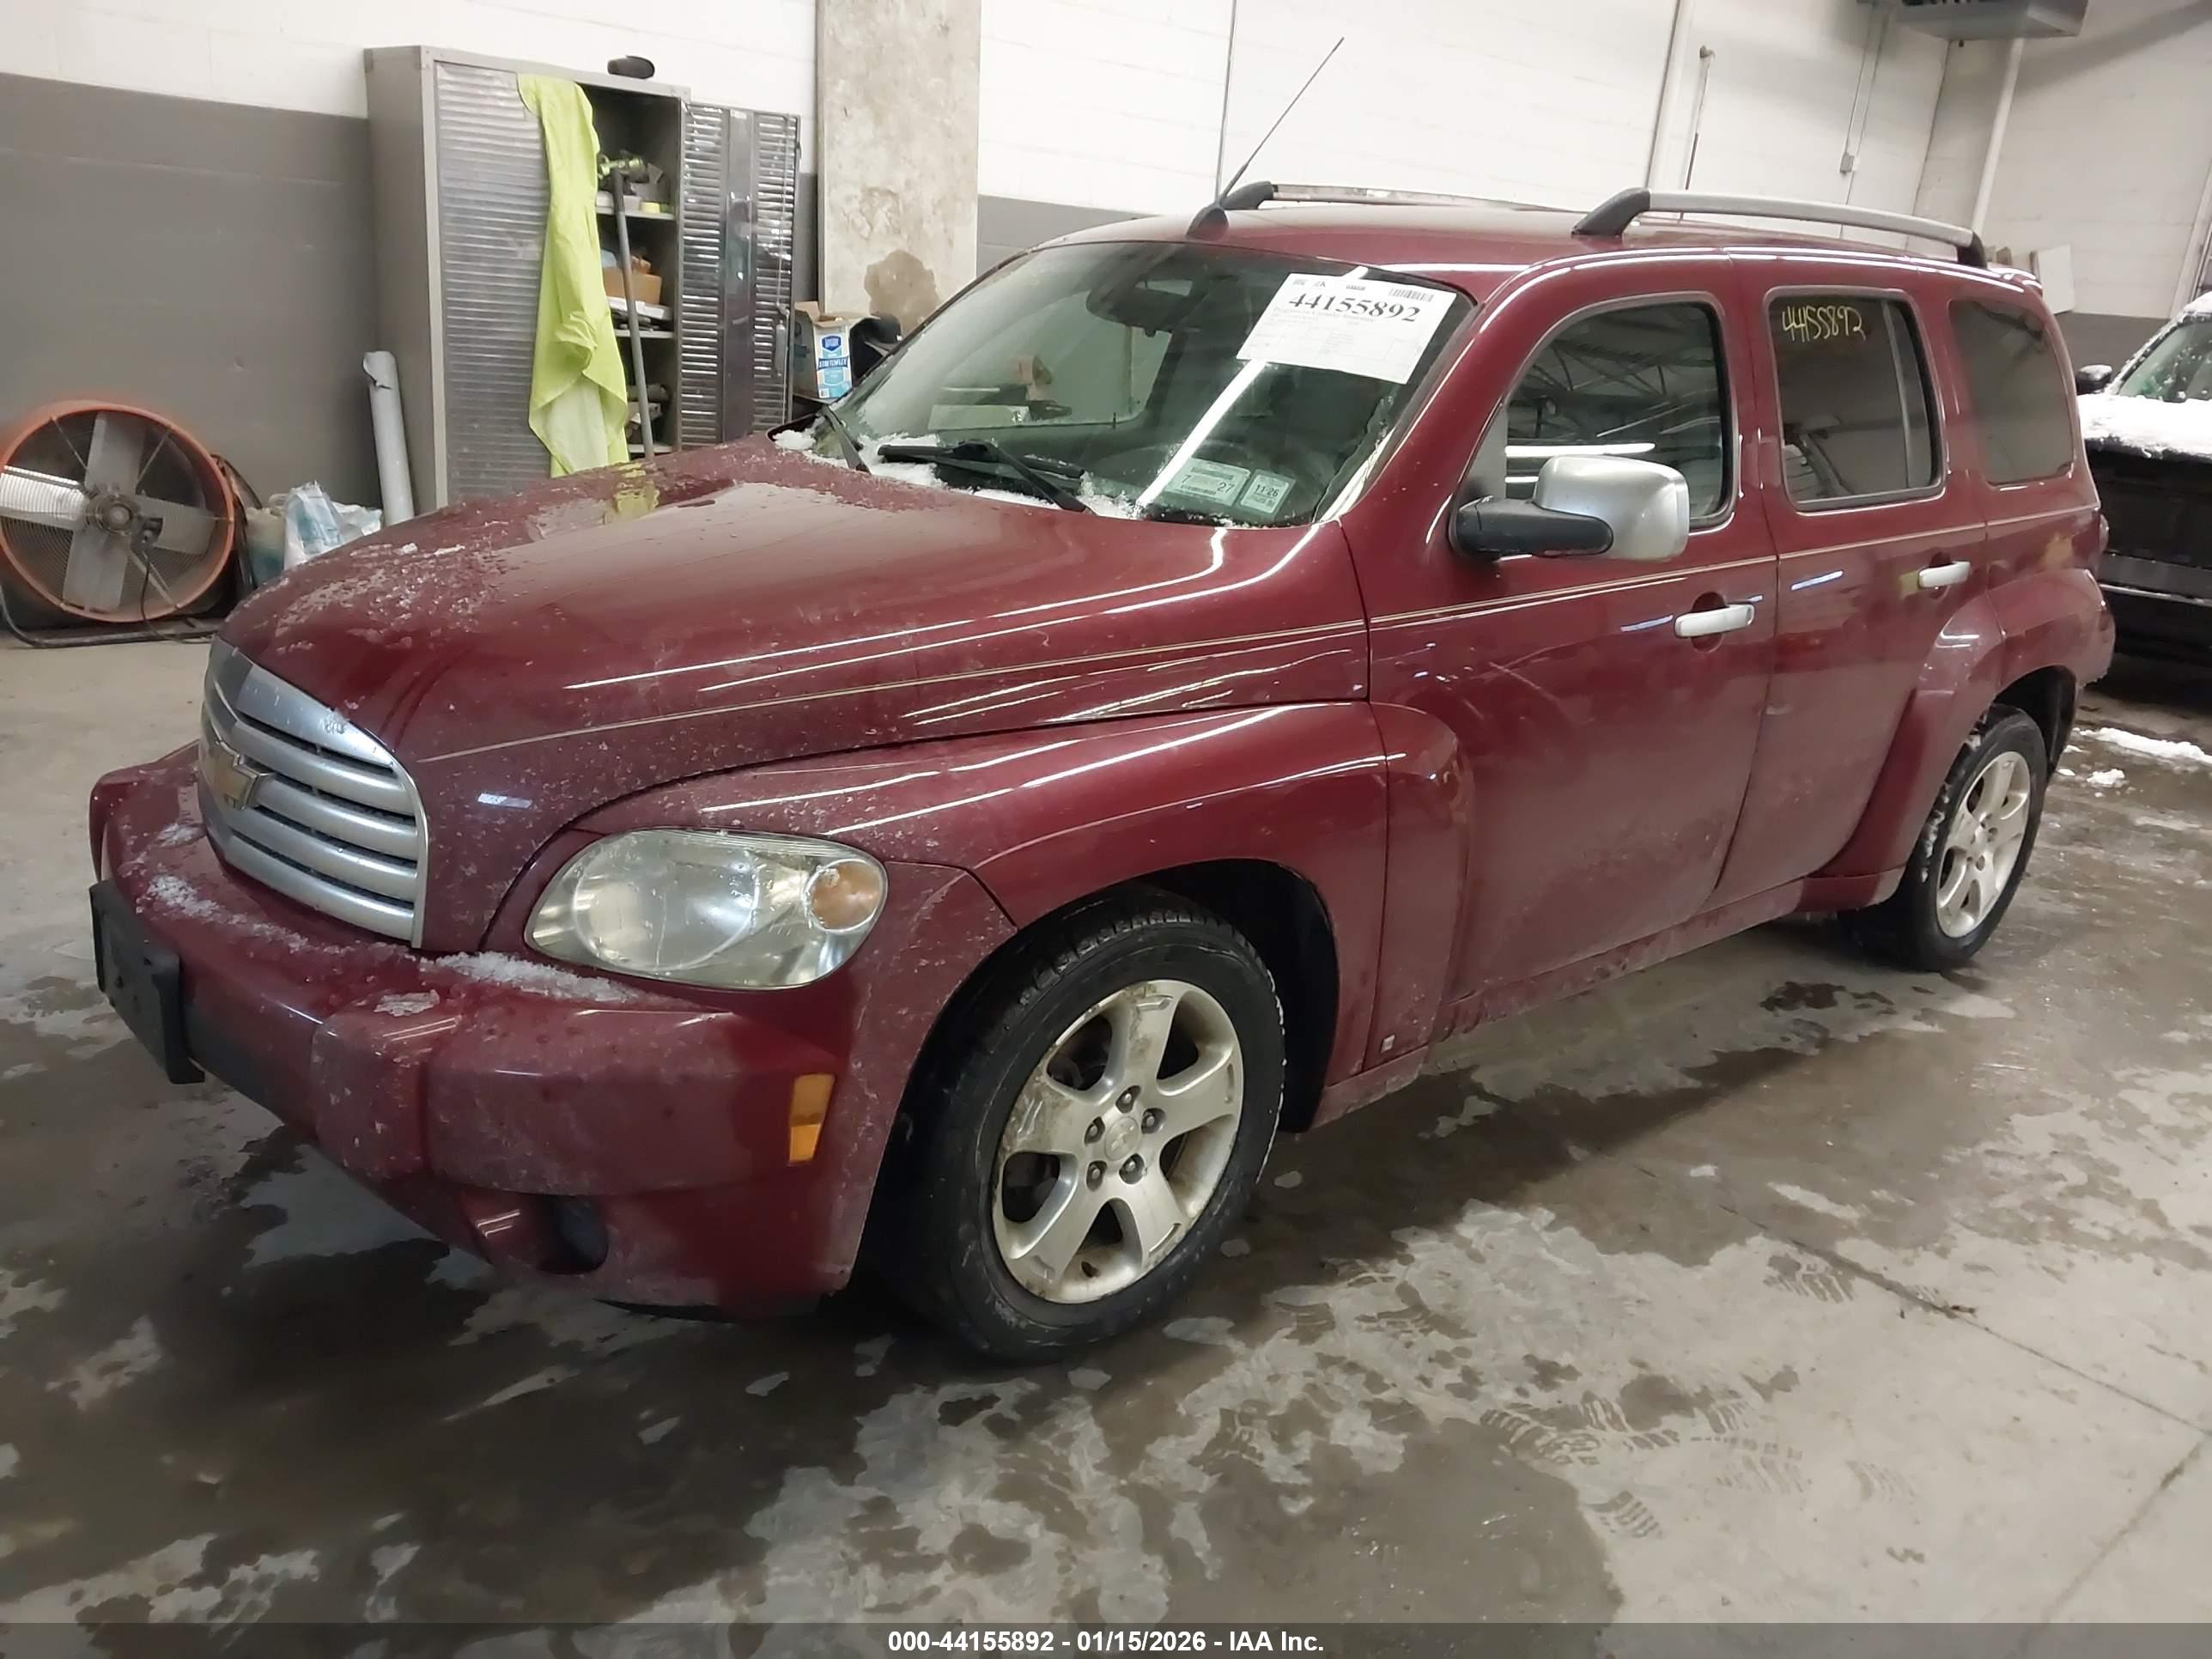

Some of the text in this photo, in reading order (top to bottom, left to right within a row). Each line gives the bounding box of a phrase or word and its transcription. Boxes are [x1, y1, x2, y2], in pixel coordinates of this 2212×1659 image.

[1289, 293, 1420, 322] 44155892
[1782, 304, 1867, 343] 44155892
[1217, 481, 1236, 494] 27
